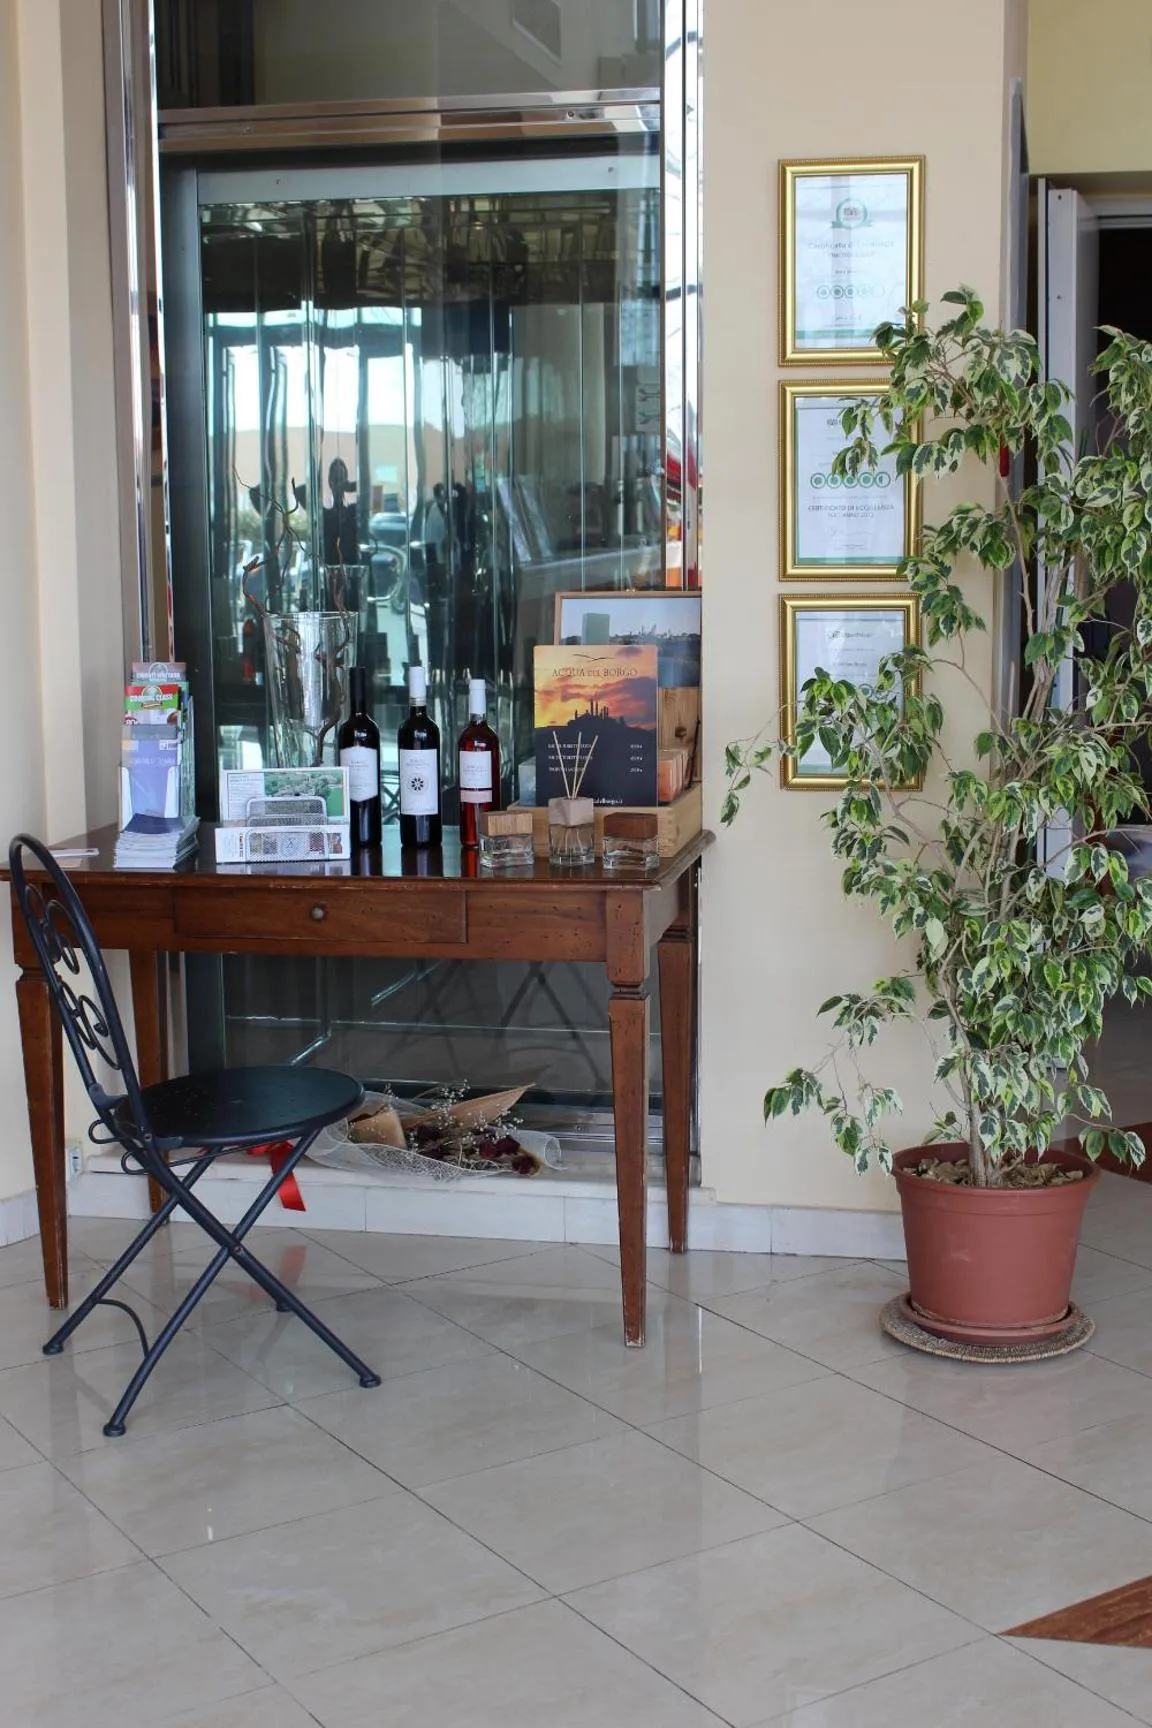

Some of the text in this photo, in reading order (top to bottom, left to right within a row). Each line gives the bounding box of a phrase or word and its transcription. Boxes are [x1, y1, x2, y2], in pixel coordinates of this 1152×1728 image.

[552, 667, 637, 677] ACQUA DEL BORGO
